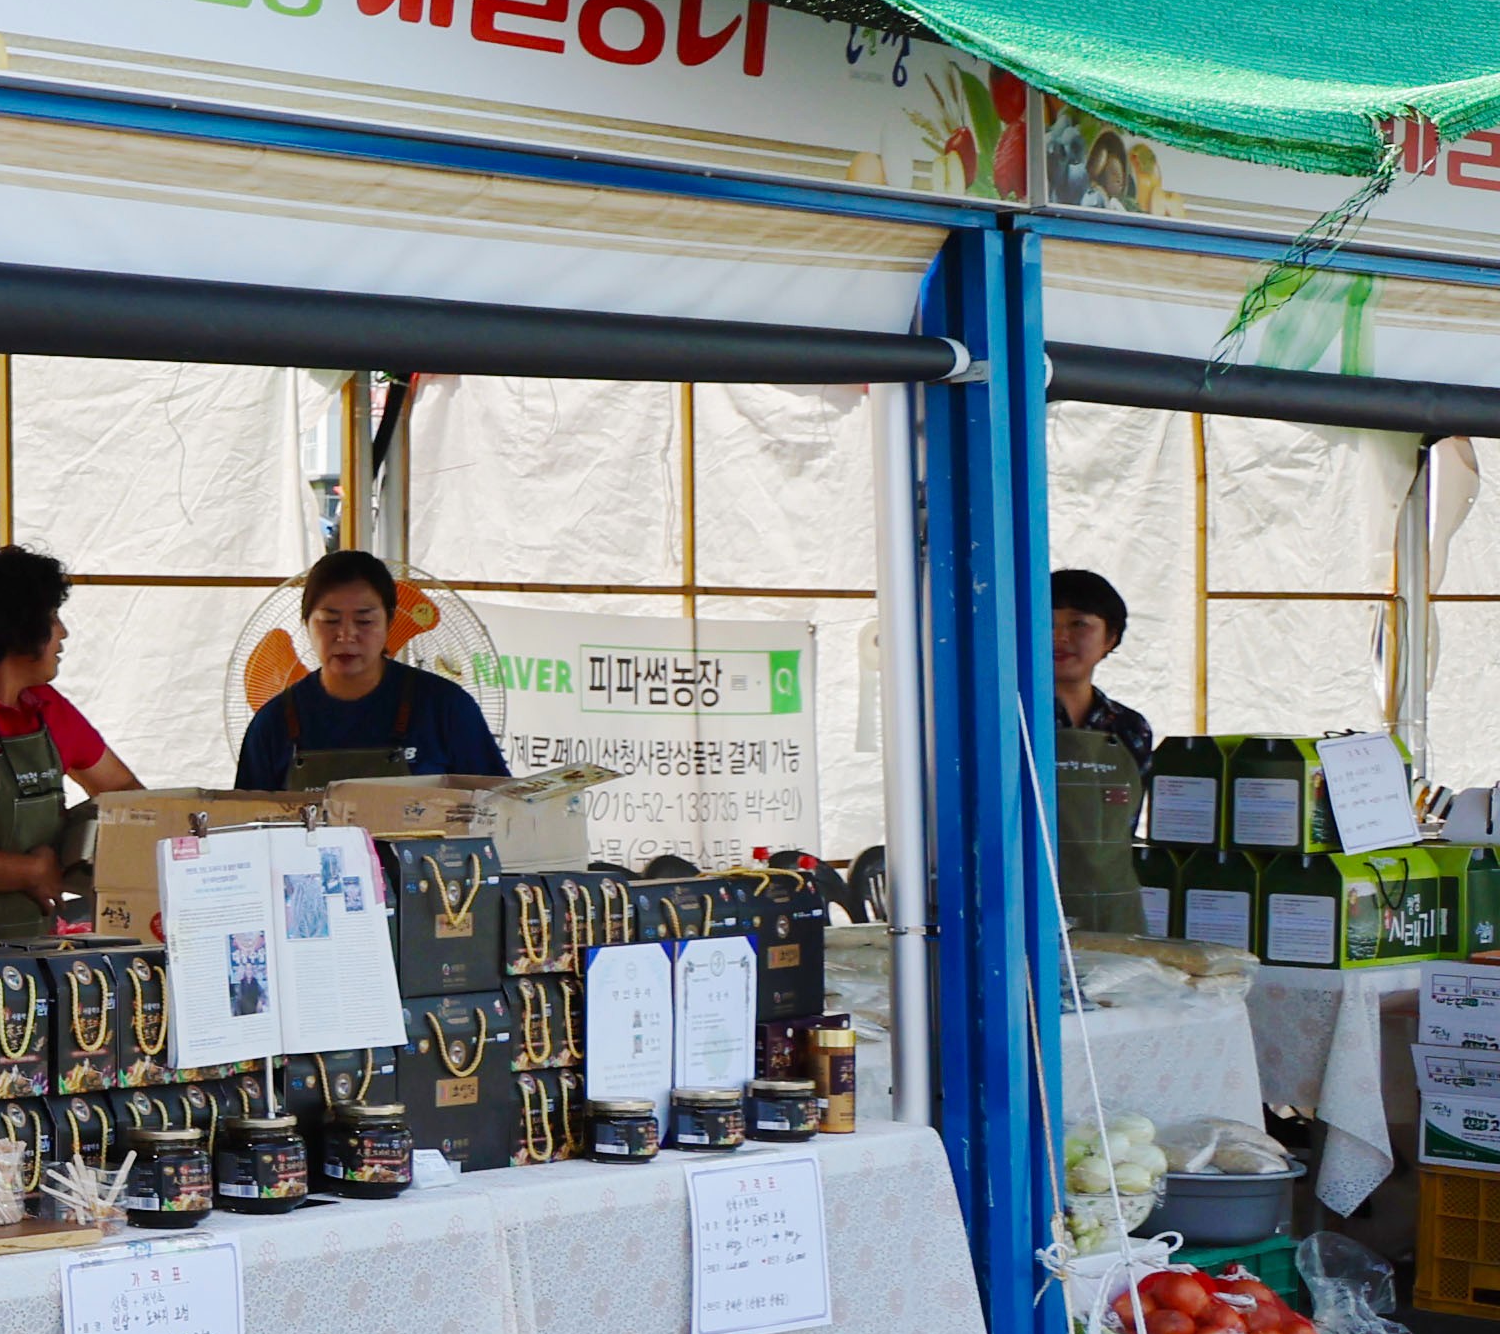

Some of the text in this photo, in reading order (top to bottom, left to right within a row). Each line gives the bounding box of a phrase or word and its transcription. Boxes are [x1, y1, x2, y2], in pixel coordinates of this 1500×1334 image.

[470, 651, 575, 695] NAVER
[588, 653, 723, 708] 피파썸농장
[727, 740, 767, 775] 결제
[771, 737, 801, 774] 가능
[1388, 909, 1436, 947] 시래기
